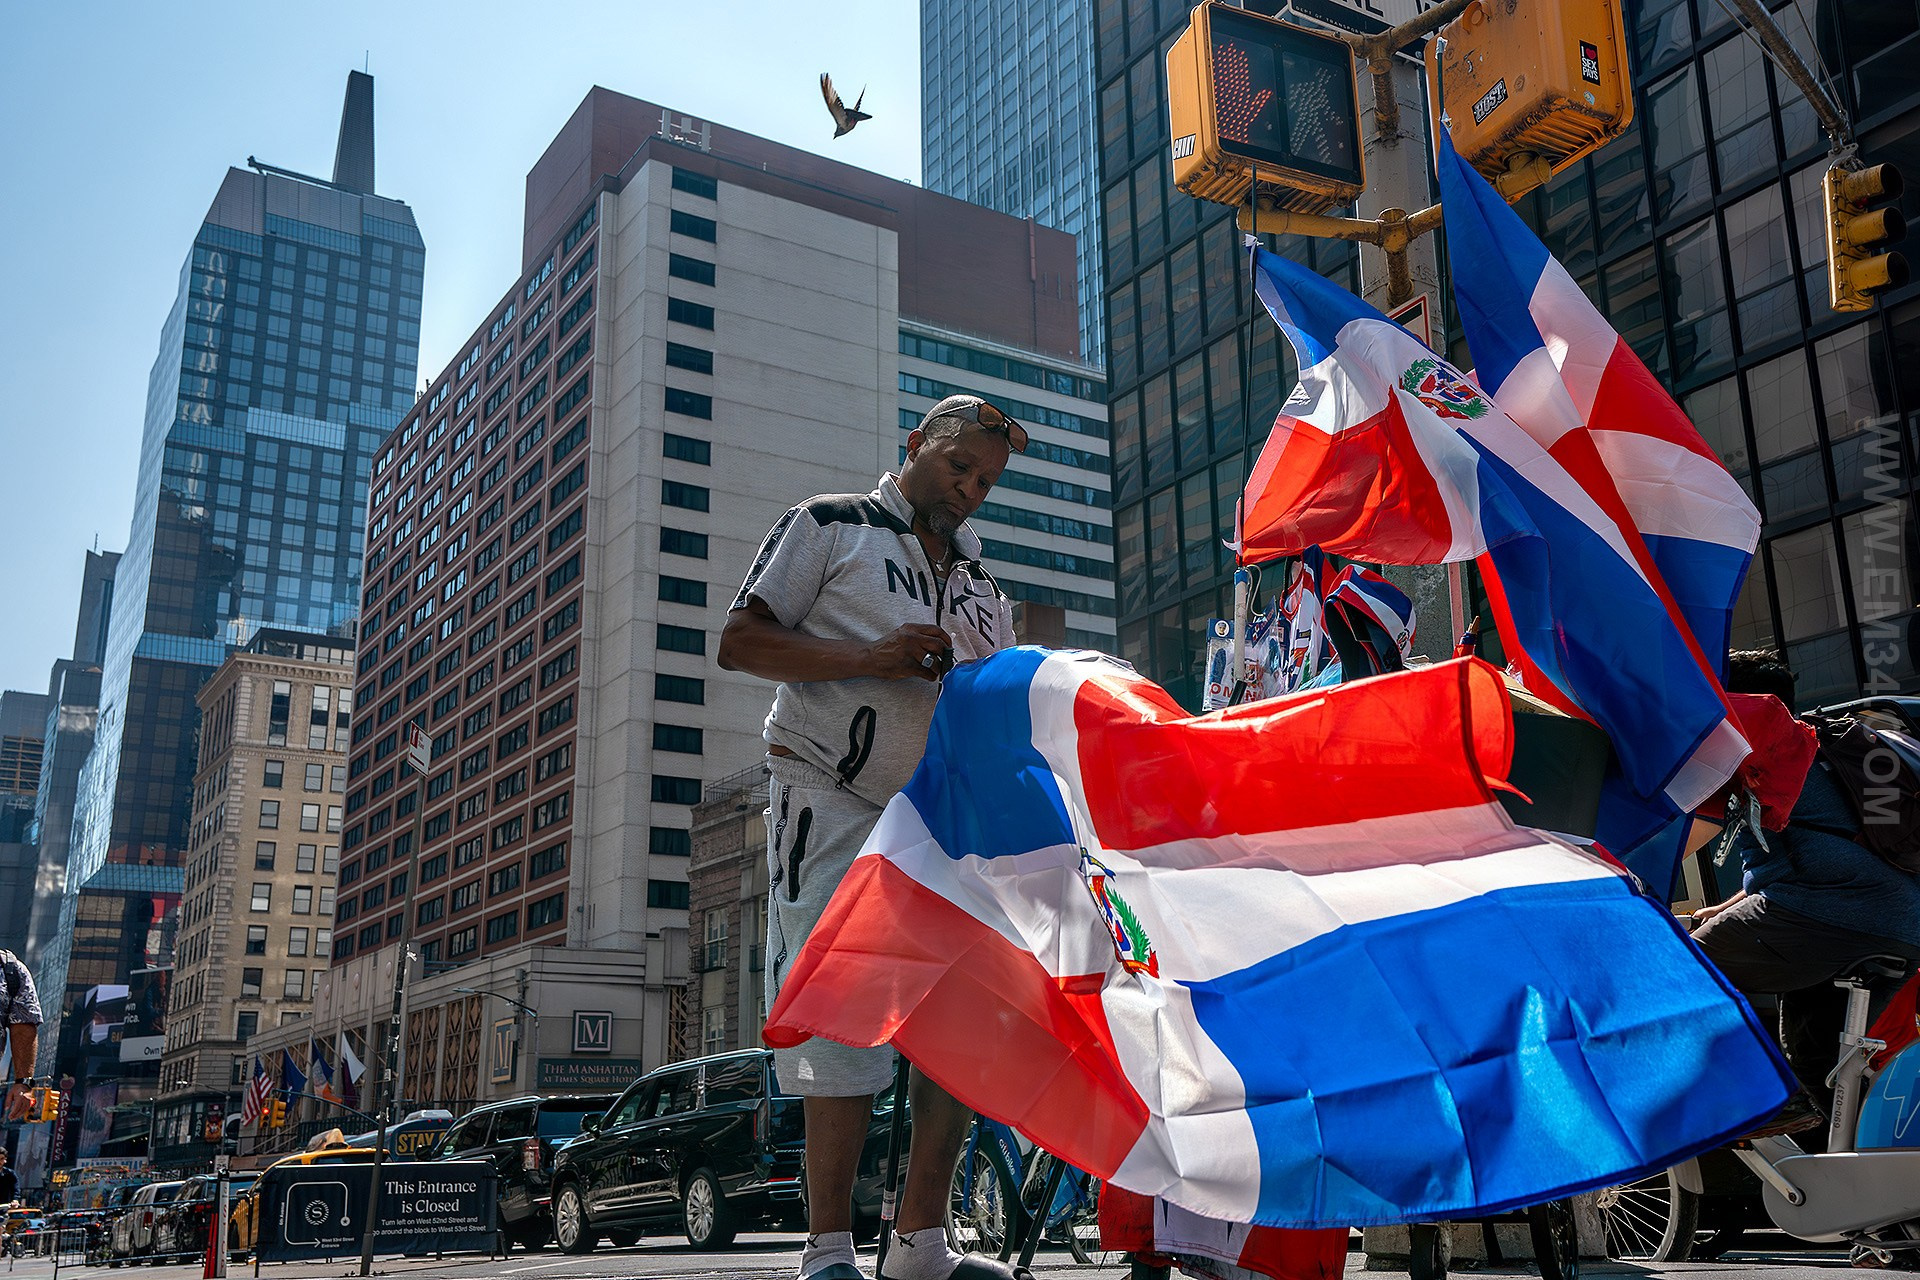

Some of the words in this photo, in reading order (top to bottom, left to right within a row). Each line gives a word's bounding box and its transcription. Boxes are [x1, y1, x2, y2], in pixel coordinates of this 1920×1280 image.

[1580, 45, 1585, 57] I
[1581, 57, 1597, 71] SEX
[1582, 66, 1599, 80] PAYS
[745, 574, 757, 590] AIR
[884, 557, 996, 649] NIKE
[580, 1018, 607, 1045] M
[543, 1063, 565, 1074] THE
[568, 1064, 639, 1075] MANHATTAN
[580, 1075, 611, 1085] SQUARE
[1832, 1083, 1845, 1129] 690-0237
[194, 1113, 203, 1137] PARK
[397, 1132, 435, 1153] STAY
[385, 1180, 415, 1195] This
[417, 1180, 477, 1194] Entrance
[311, 1206, 323, 1219] S
[401, 1200, 413, 1213] is
[415, 1198, 460, 1213] Closed
[416, 1217, 432, 1225] West
[448, 1216, 466, 1224] Street
[381, 1228, 402, 1236] around
[414, 1226, 430, 1234] block
[437, 1225, 454, 1233] West
[468, 1224, 487, 1232] Street
